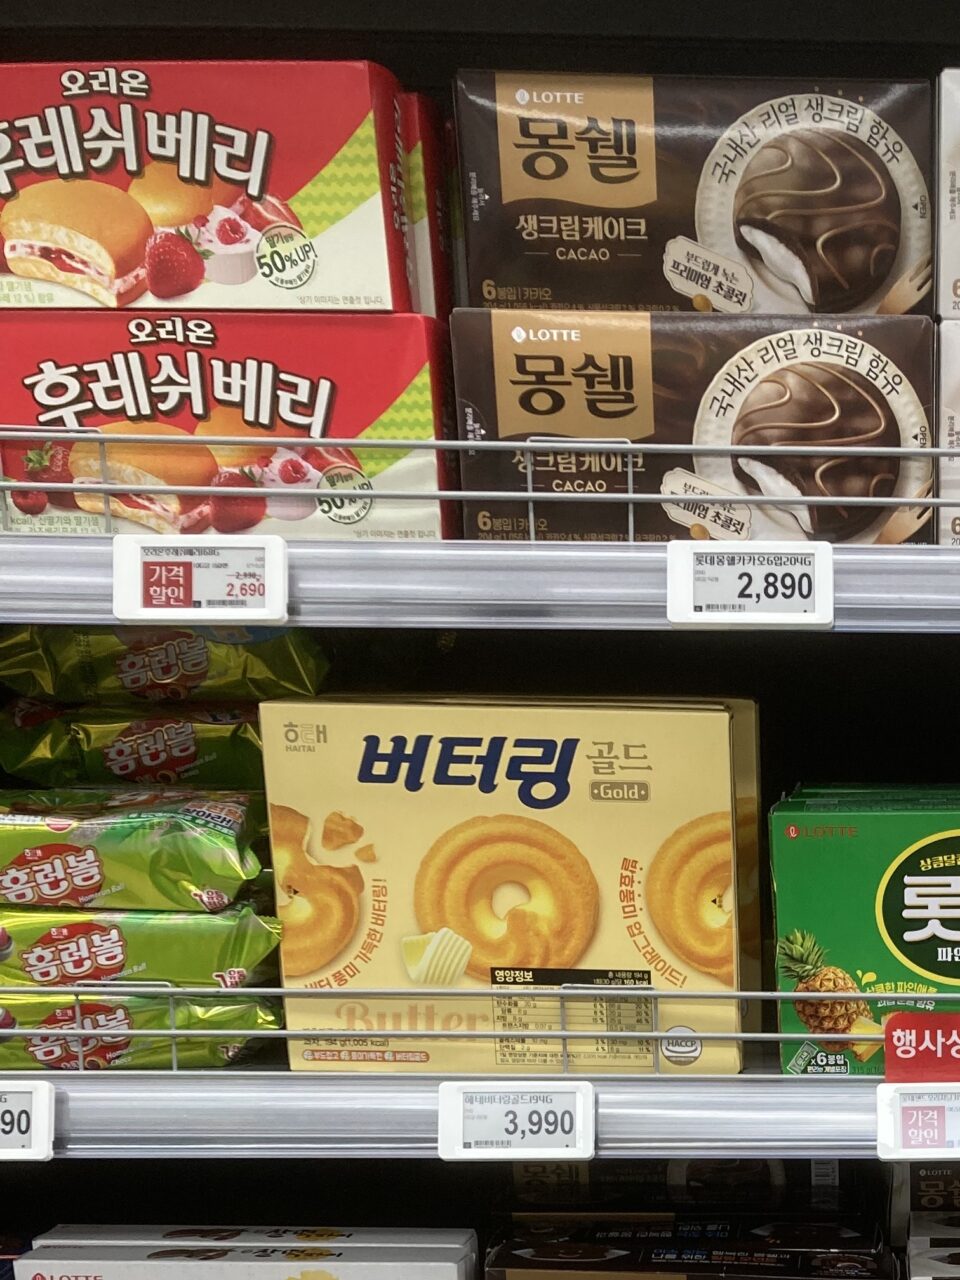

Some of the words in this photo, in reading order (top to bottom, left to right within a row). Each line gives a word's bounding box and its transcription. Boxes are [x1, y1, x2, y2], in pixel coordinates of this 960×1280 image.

[61, 69, 149, 96] 오리온
[532, 91, 584, 104] LOTTE
[513, 116, 640, 185] 몽쉘
[711, 120, 761, 185] 국내산
[760, 99, 799, 130] 리얼
[803, 96, 866, 130] 생크림
[866, 120, 905, 164] 함유
[515, 215, 648, 241] 생크림케이크
[556, 247, 610, 261] CACAO
[128, 318, 215, 345] 오리온
[24, 352, 206, 430] 후레쉬
[210, 359, 334, 439] 베리
[510, 352, 637, 418] 몽쉘
[149, 566, 185, 585] 가격
[738, 571, 813, 604] 2,890
[150, 586, 185, 606] 할인
[226, 582, 266, 600] 2,690
[105, 722, 197, 772] 홈런볼
[357, 734, 581, 810] 버터링
[585, 741, 653, 775] 골드
[599, 784, 640, 800] Gold
[802, 826, 858, 837] LOTTE
[332, 961, 361, 987] 풍미
[354, 928, 383, 964] 가득한
[371, 879, 388, 927] 버터링!
[22, 928, 126, 984] 홈런볼
[495, 971, 534, 982] 영양정보
[504, 1110, 574, 1137] 3,990
